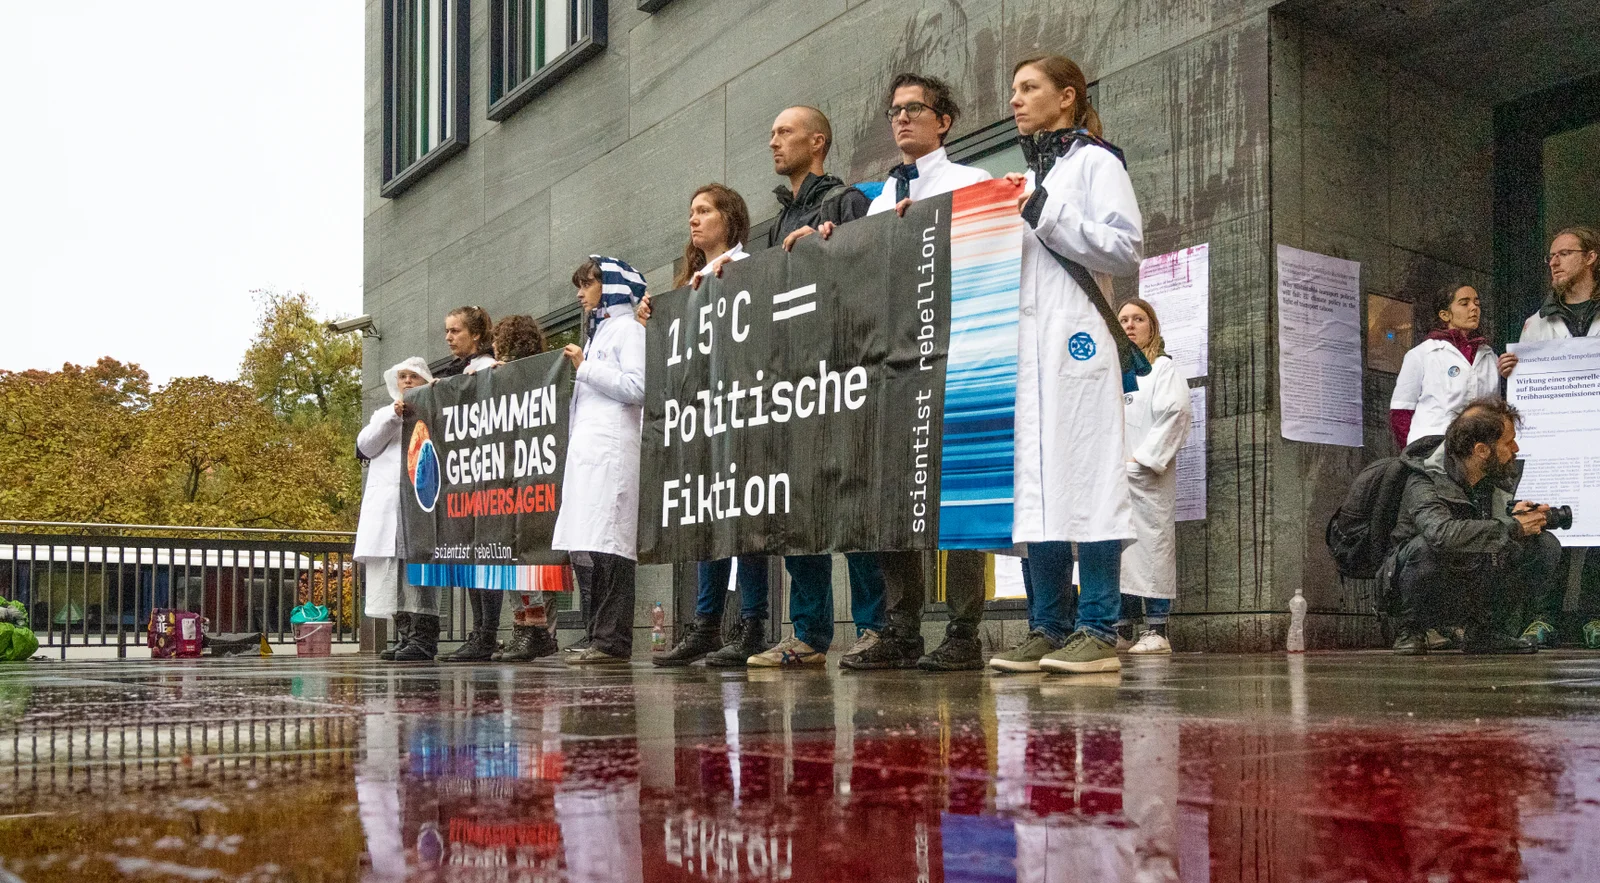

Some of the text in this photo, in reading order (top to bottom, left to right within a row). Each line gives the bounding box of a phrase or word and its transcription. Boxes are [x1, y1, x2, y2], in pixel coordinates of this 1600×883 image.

[1282, 280, 1292, 290] Why
[1318, 288, 1339, 299] transport
[1298, 300, 1319, 310] transport
[1328, 298, 1342, 308] policy
[666, 282, 817, 367] 1.5°C =
[1516, 378, 1546, 386] Wirkung
[1529, 382, 1596, 392] Bundesautobahnen
[442, 384, 556, 442] ZUSAMMEN
[664, 359, 868, 447] Politische
[446, 434, 556, 486] GEGEN DAS
[910, 388, 932, 533] scientist
[446, 483, 556, 518] KLIMAVERSAGEN
[662, 462, 790, 528] Fiktion
[434, 544, 471, 560] scientist
